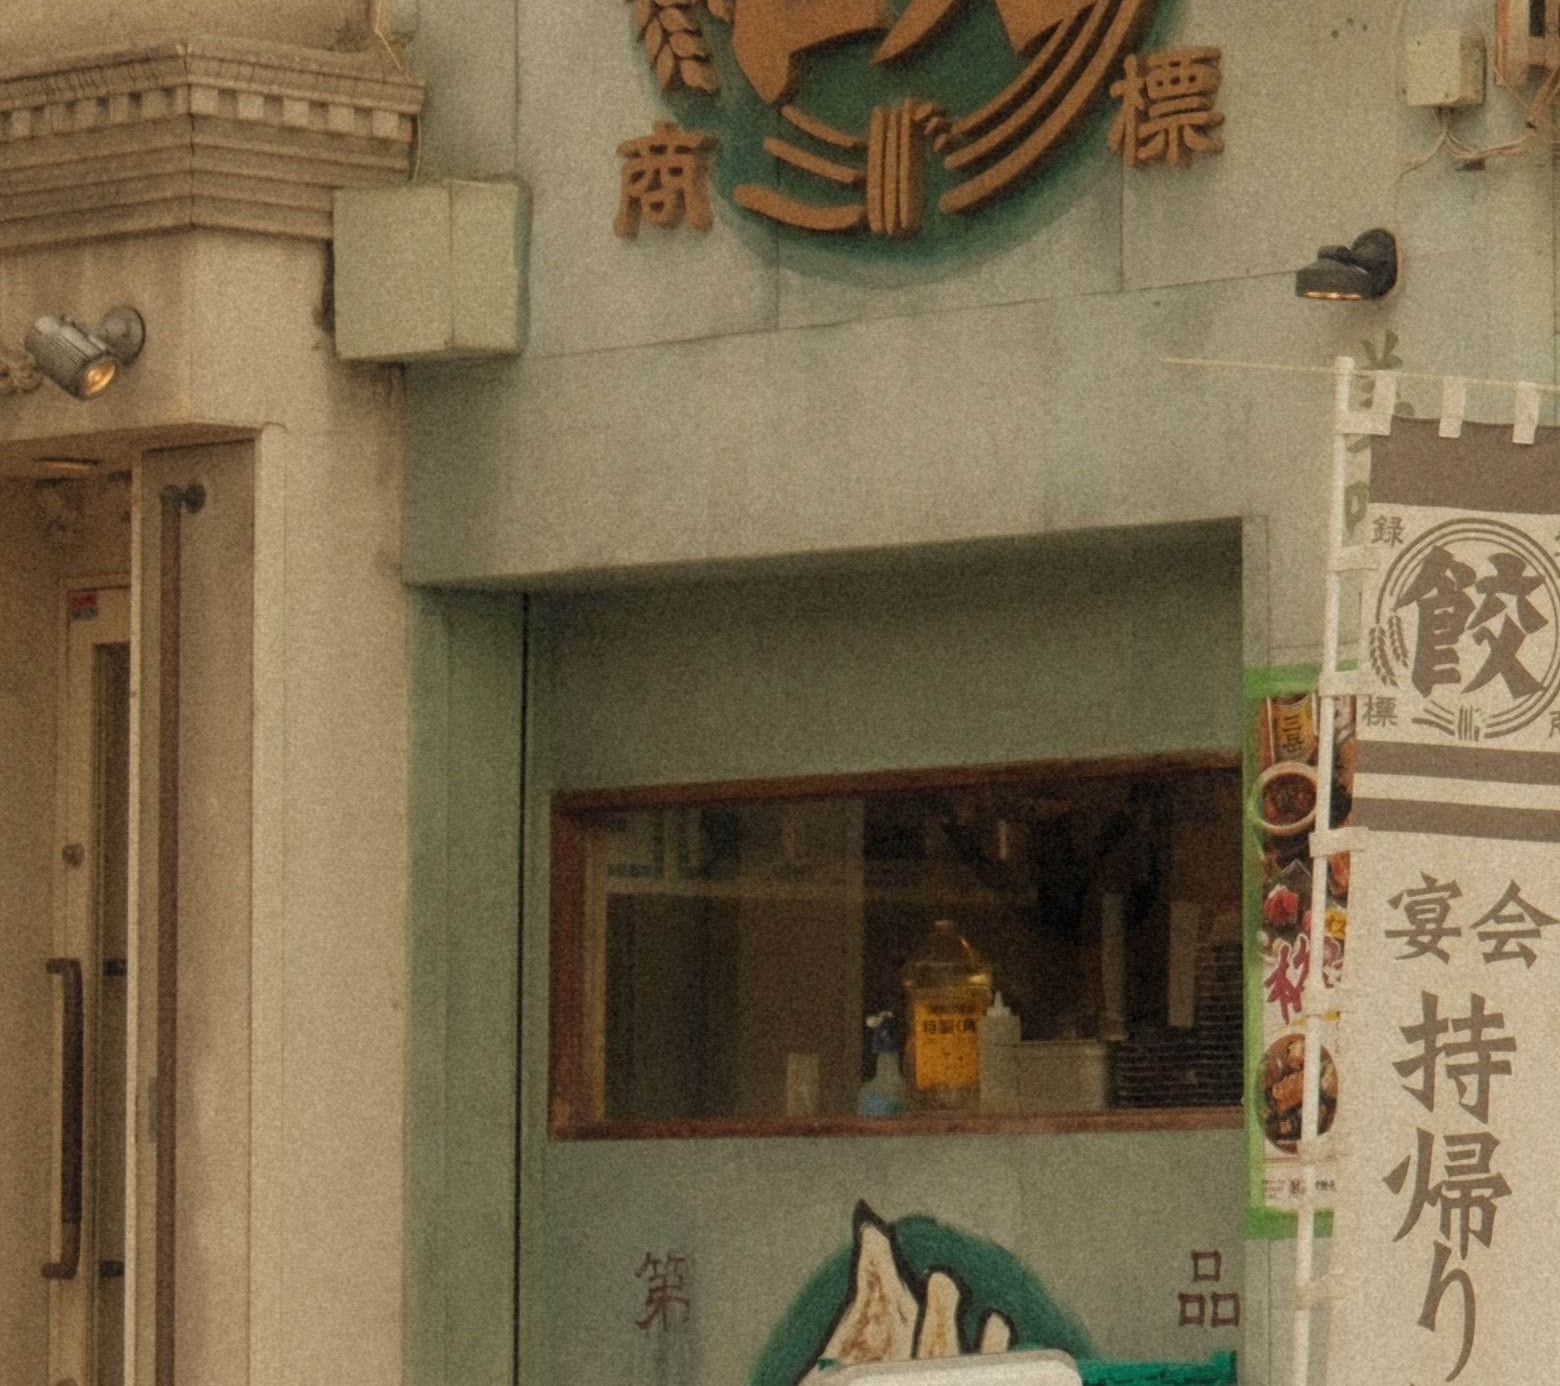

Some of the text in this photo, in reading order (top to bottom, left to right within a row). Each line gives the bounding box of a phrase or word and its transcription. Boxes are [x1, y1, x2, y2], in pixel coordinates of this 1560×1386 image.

[1107, 47, 1226, 169] 標
[613, 121, 718, 239] 商
[1370, 514, 1405, 548] 録
[1393, 544, 1549, 699] 餃
[1384, 871, 1560, 971] 宴会
[634, 1252, 693, 1332] 第
[1177, 1250, 1242, 1328] 品
